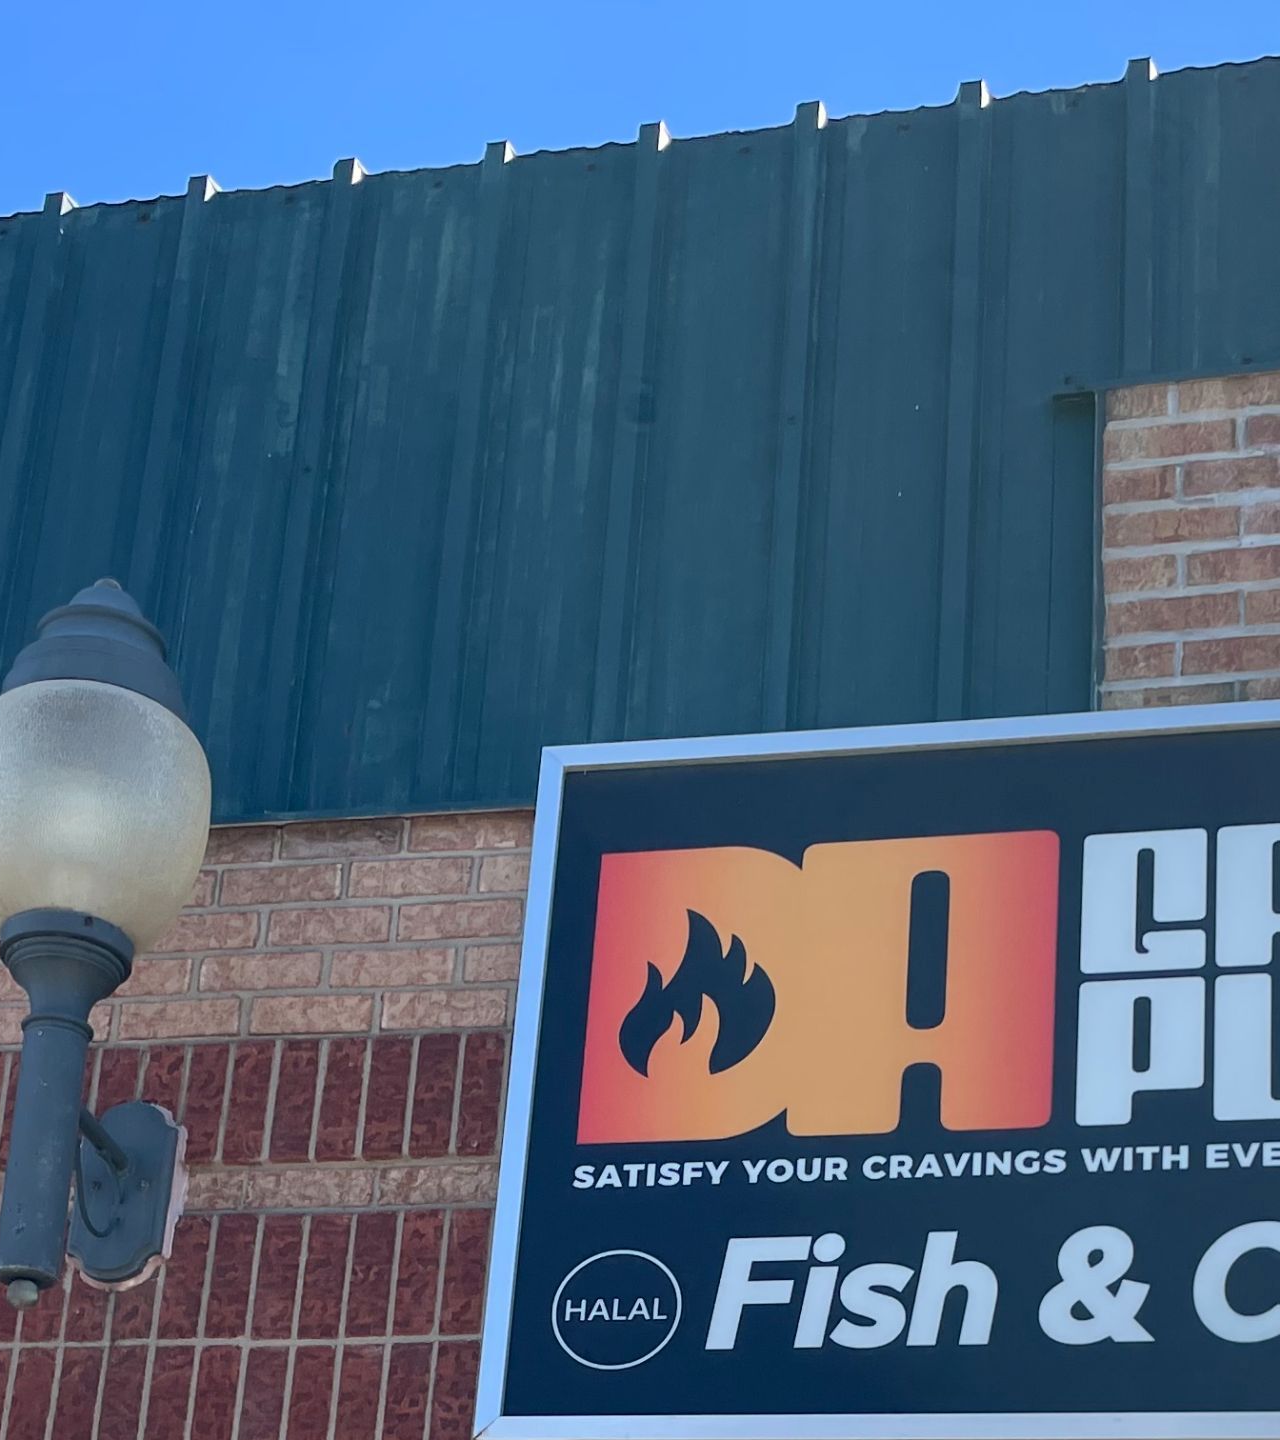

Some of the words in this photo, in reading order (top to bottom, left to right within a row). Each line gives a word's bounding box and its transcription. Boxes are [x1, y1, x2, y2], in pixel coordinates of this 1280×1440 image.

[576, 829, 1061, 1145] DA
[572, 1160, 728, 1190] SATISFY
[742, 1156, 848, 1186] YOUR
[861, 1148, 1067, 1181] CRAVINGS
[1080, 1144, 1190, 1173] WITH
[564, 1296, 668, 1325] HALAL
[705, 1230, 998, 1352] Fish
[1037, 1224, 1156, 1344] &
